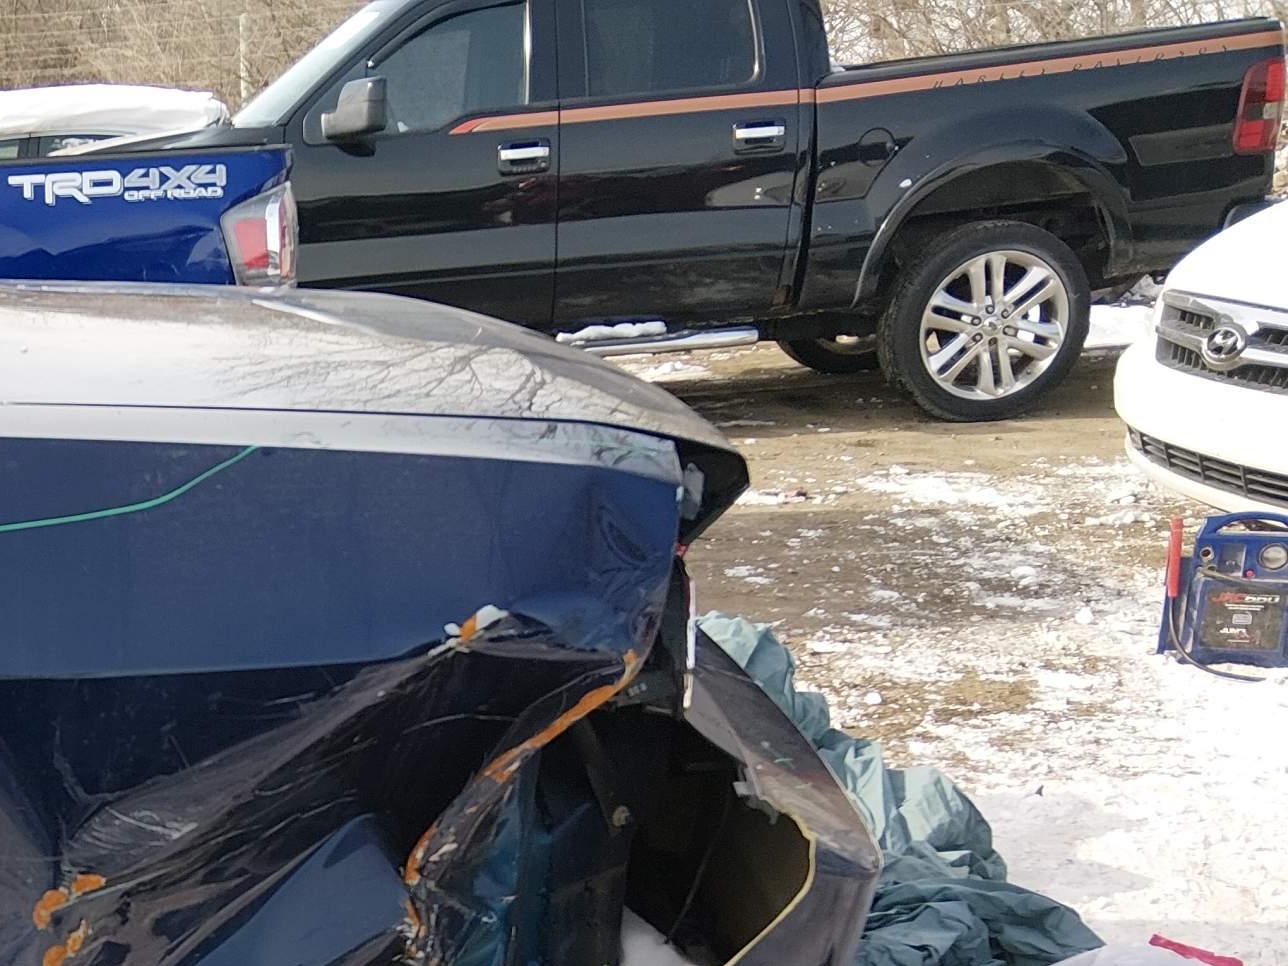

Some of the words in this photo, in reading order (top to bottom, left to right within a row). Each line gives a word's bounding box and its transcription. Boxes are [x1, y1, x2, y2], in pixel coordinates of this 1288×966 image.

[8, 169, 123, 206] TRD
[124, 164, 227, 191] 4X4
[124, 189, 163, 203] OFF
[166, 186, 224, 201] ROAD
